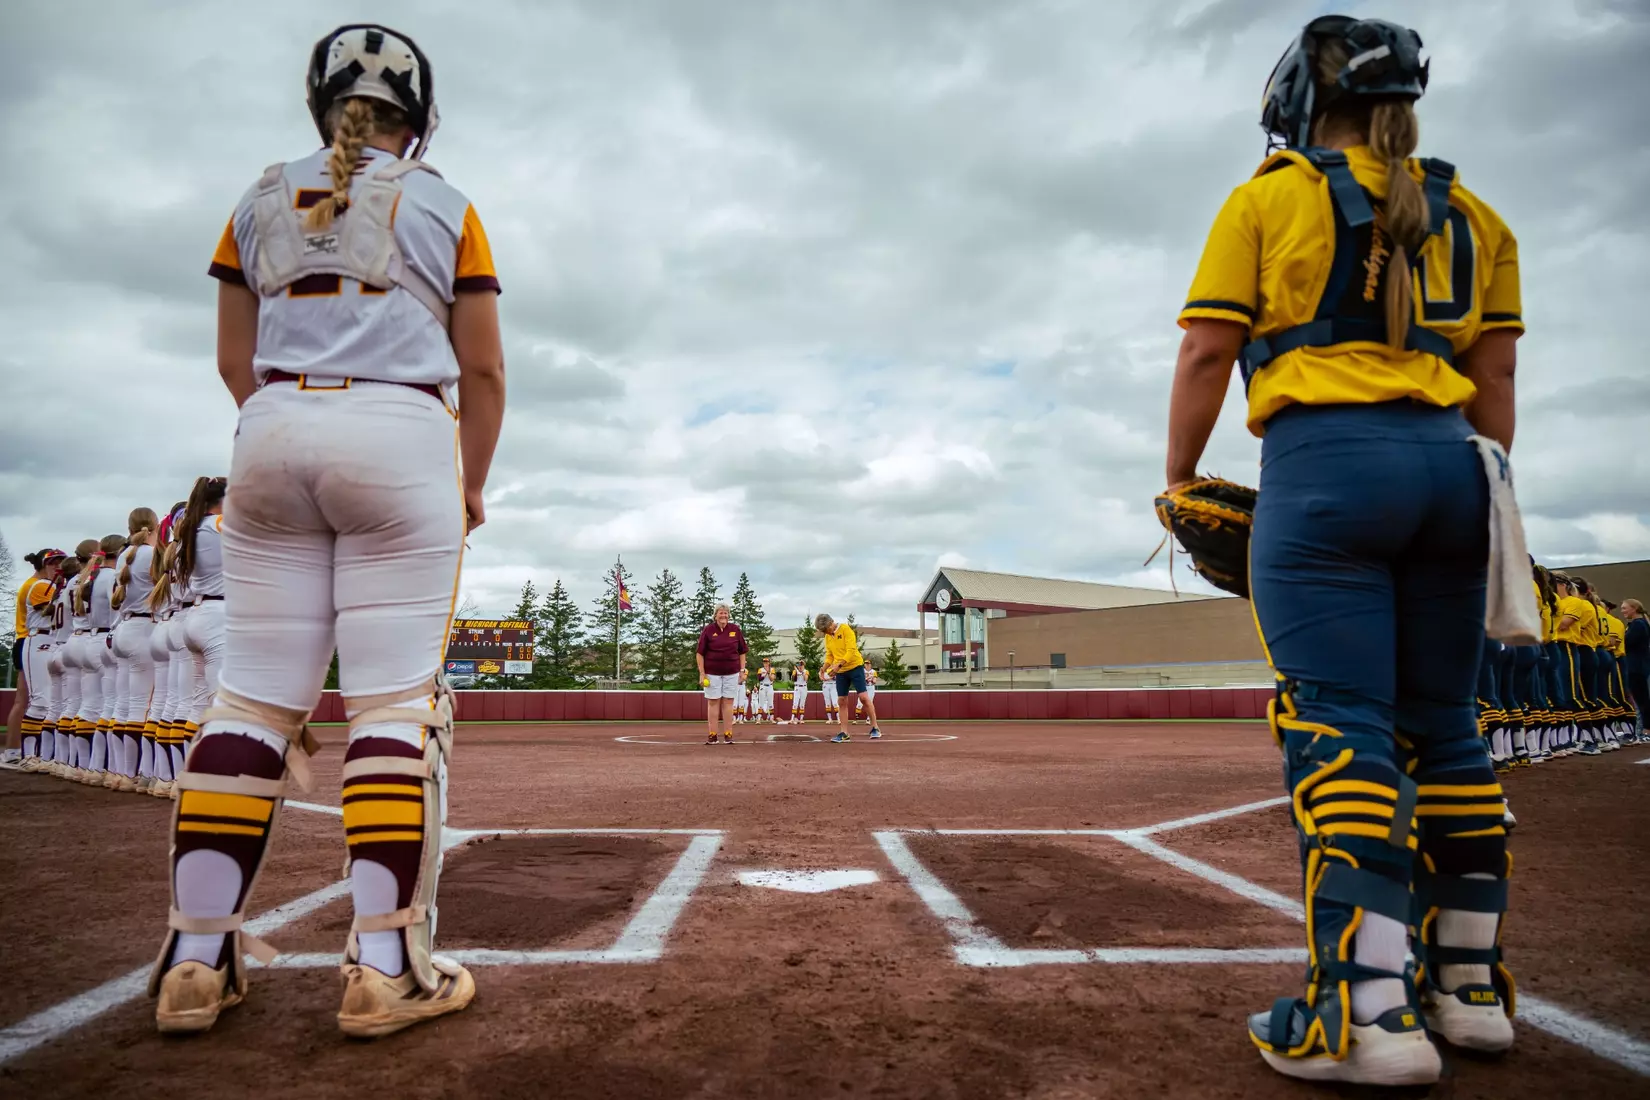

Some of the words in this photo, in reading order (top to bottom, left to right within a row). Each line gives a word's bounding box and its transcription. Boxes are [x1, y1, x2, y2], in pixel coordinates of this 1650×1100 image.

[499, 621, 529, 629] SOFTBALL
[1598, 617, 1609, 636] 13
[495, 634, 500, 642] 0
